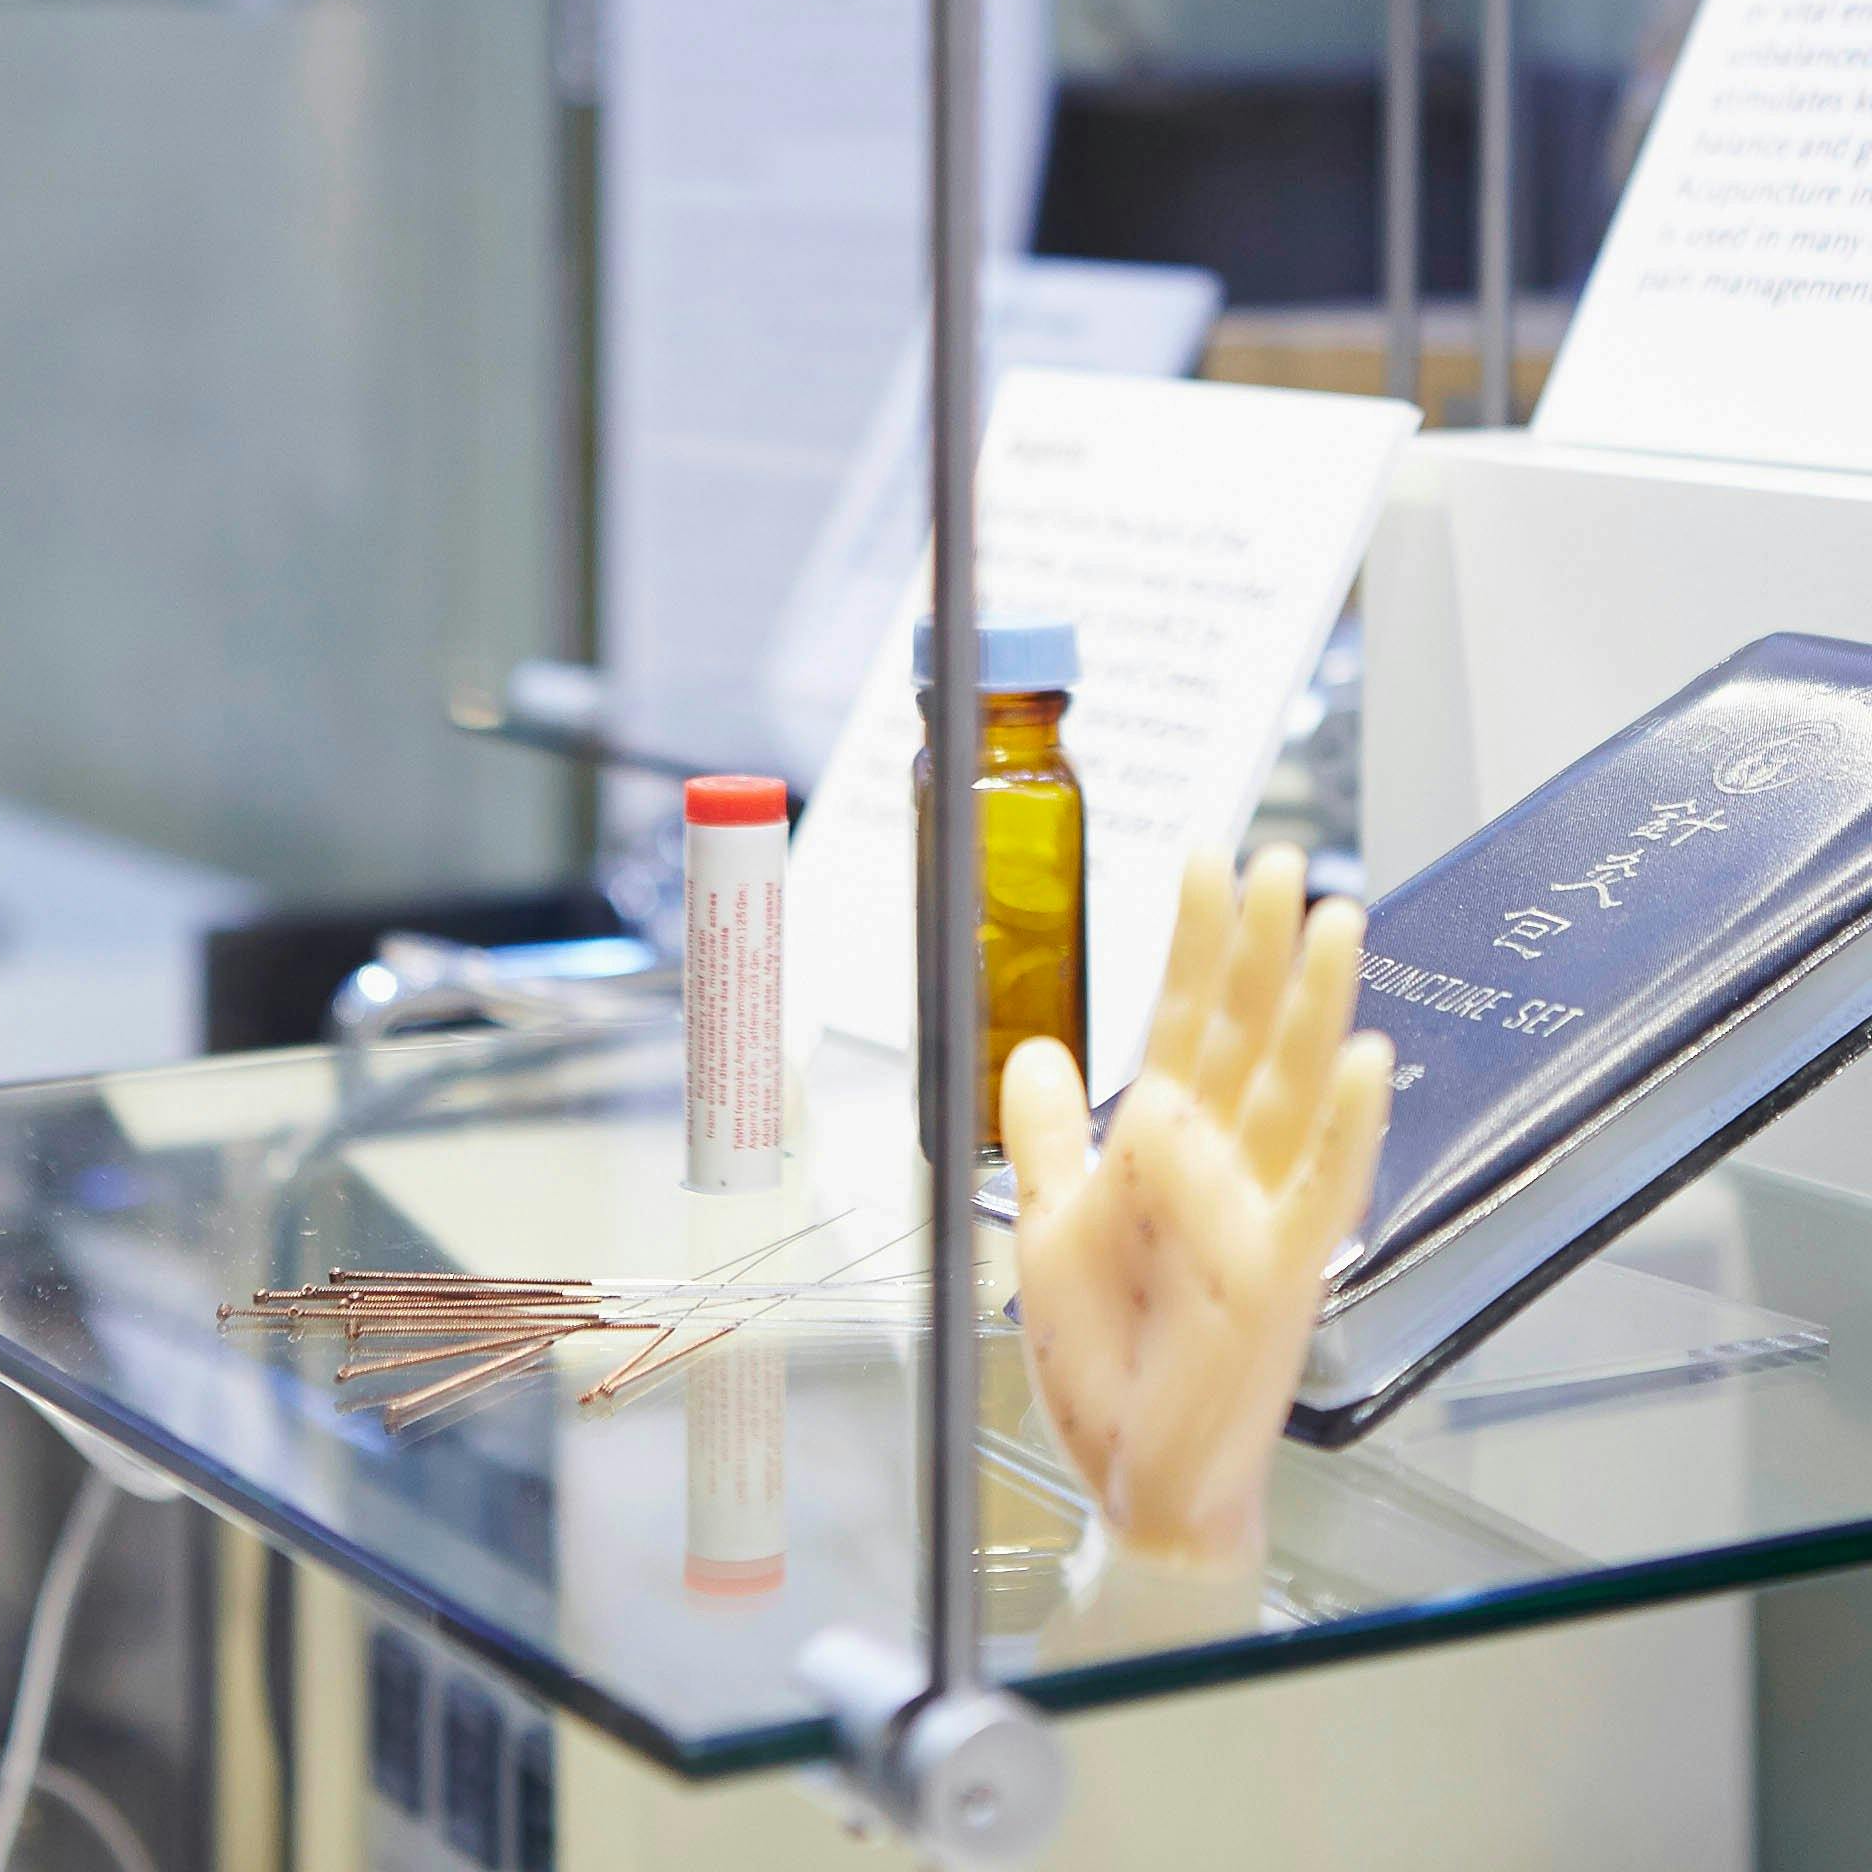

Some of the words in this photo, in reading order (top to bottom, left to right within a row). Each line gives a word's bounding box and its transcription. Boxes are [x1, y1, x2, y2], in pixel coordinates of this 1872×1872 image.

[1798, 134, 1849, 161] and
[1675, 180, 1842, 210] Acupuncture
[1685, 223, 1748, 249] used
[1788, 231, 1860, 261] many
[719, 964, 728, 976] to
[719, 980, 728, 1002] due
[749, 1004, 760, 1049] Caffeine
[1502, 998, 1584, 1038] SET
[718, 1084, 727, 1106] and
[706, 1110, 716, 1139] from
[734, 1117, 745, 1151] Tablet
[749, 1111, 760, 1150] Aspirin
